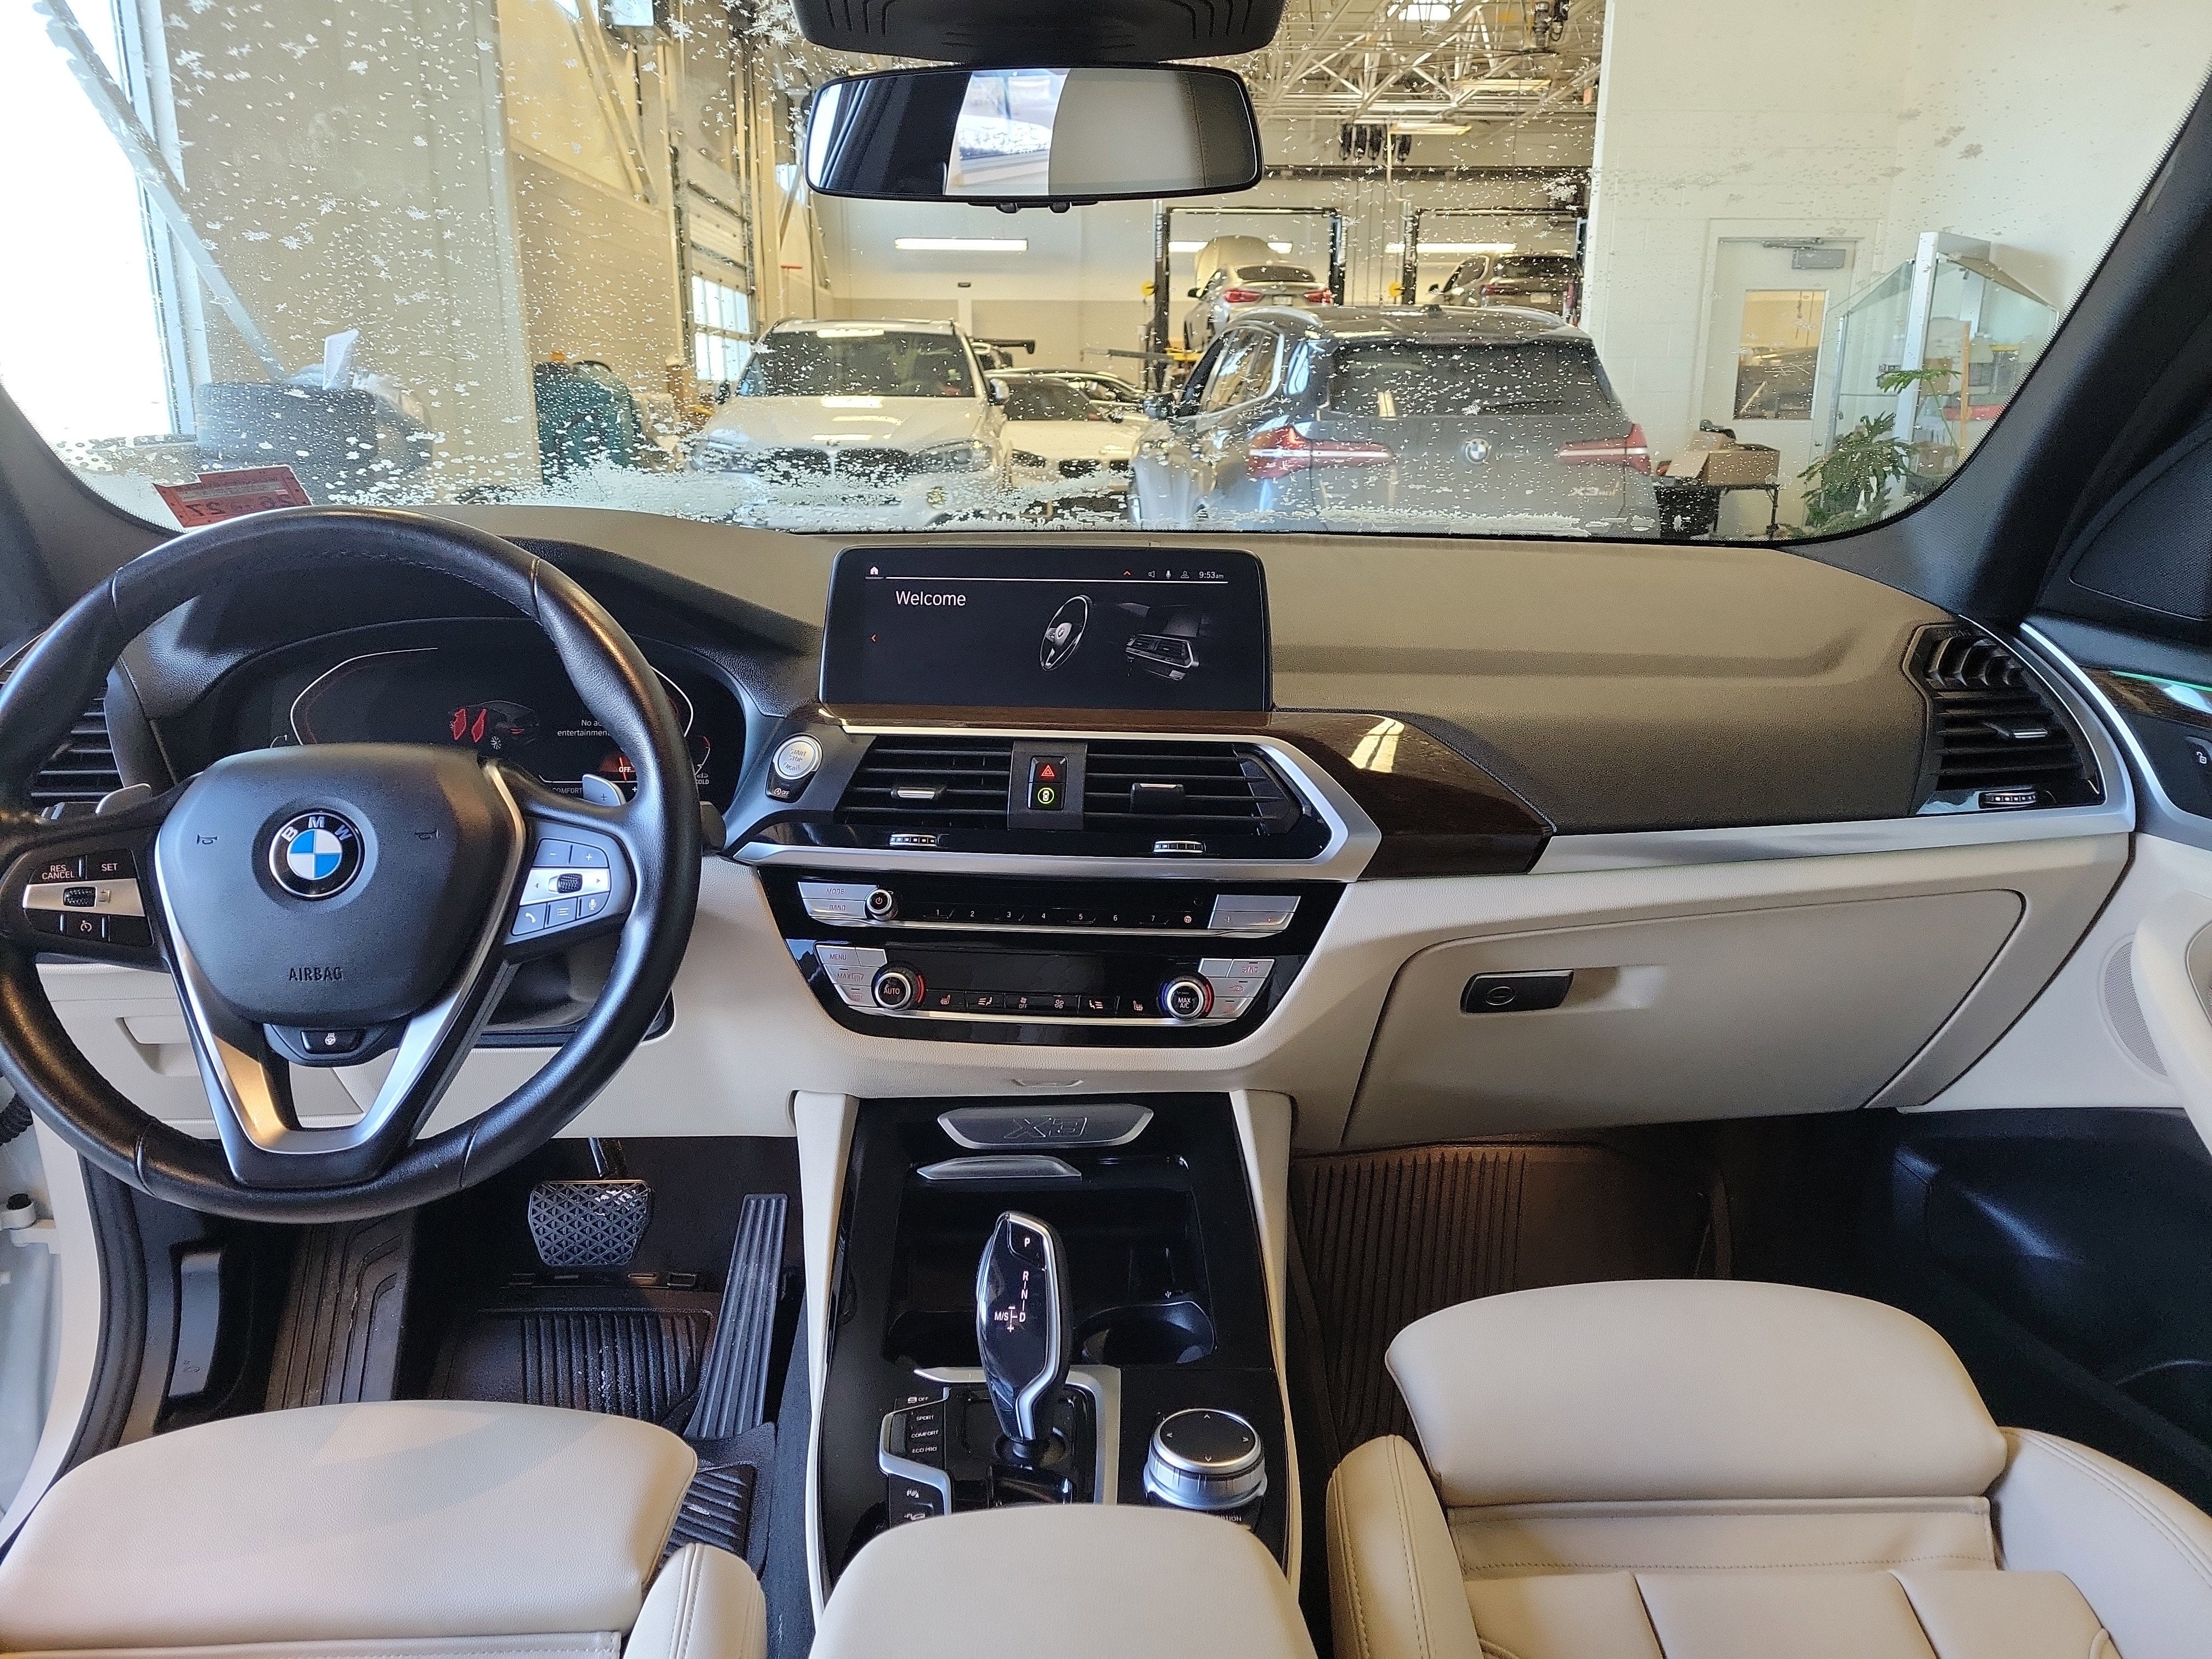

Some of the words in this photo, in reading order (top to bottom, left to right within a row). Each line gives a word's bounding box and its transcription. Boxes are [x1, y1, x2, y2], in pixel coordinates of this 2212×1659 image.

[895, 590, 967, 606] Welcome
[790, 748, 808, 757] START
[783, 761, 802, 771] ENGINE
[281, 816, 353, 842] BMW
[101, 863, 119, 871] SET
[42, 871, 76, 880] CANCEL
[289, 966, 343, 981] AIRBAG
[1024, 1237, 1030, 1248] P
[1022, 1271, 1029, 1282] R
[1021, 1289, 1028, 1300] N
[994, 1311, 1009, 1321] M/S
[1019, 1312, 1026, 1322] D
[911, 1429, 939, 1438] COMFORT
